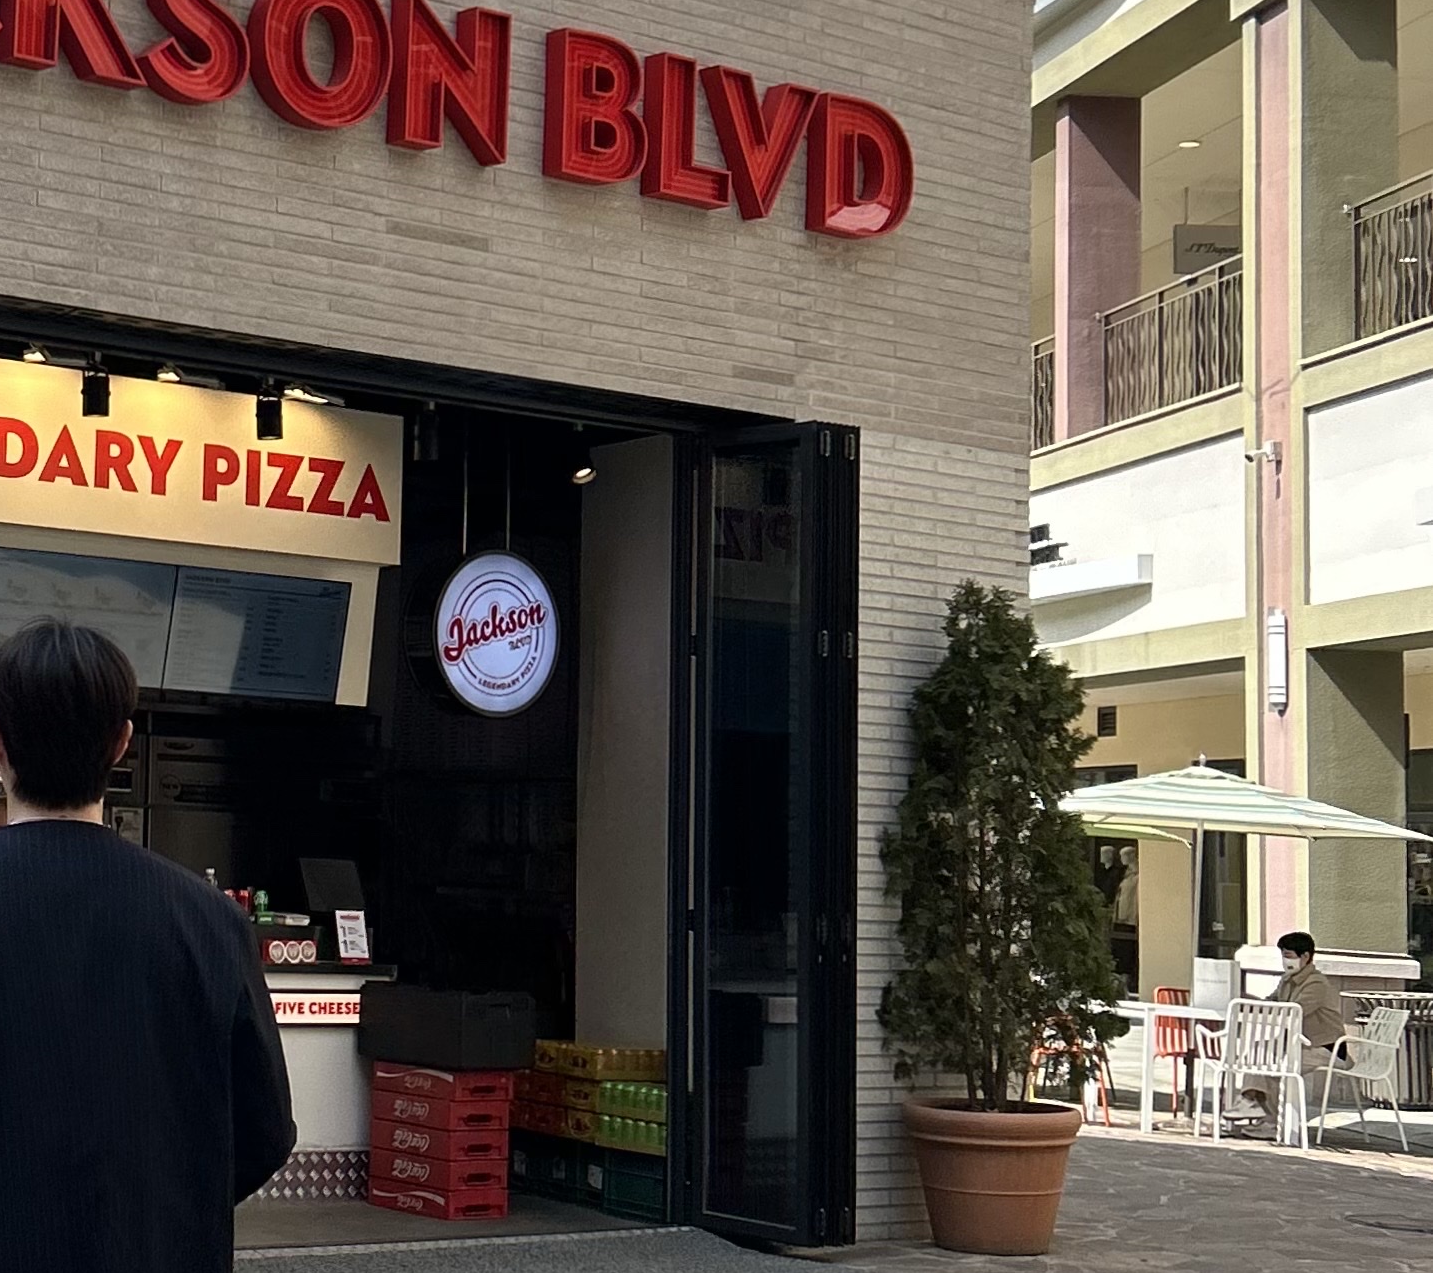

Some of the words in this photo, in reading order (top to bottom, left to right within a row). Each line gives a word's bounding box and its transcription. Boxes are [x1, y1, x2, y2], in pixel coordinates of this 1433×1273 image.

[541, 27, 914, 240] BLVD
[202, 444, 391, 523] PIZZA
[442, 601, 547, 663] Jackson
[275, 1002, 305, 1015] FIVE
[308, 1002, 361, 1015] CHEESE
